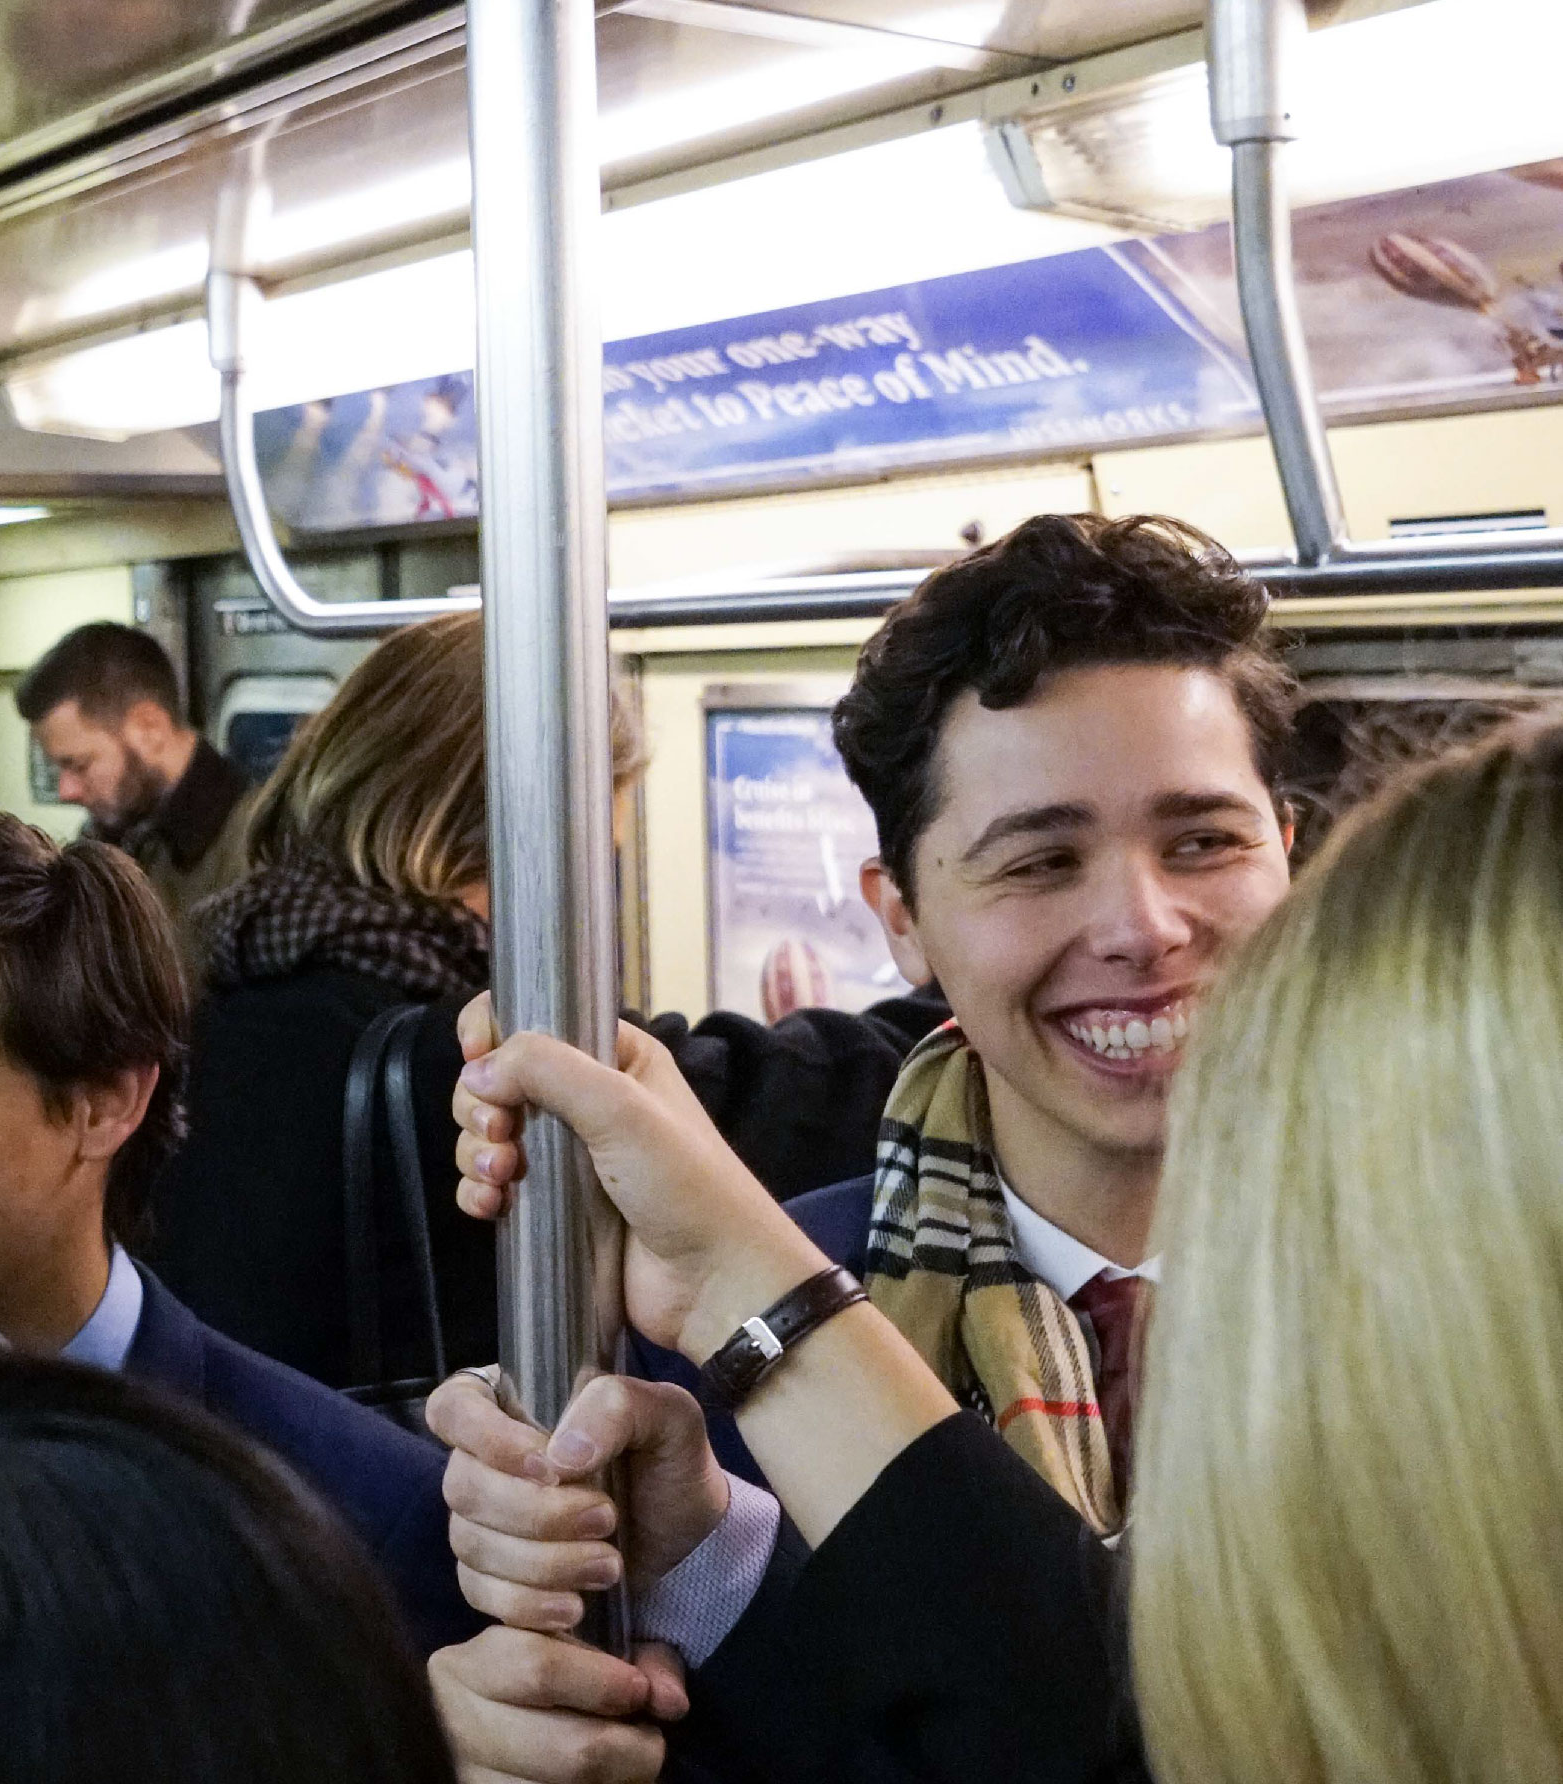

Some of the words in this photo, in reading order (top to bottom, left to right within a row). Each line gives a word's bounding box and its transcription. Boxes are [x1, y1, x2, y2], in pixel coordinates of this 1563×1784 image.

[624, 347, 730, 393] your
[725, 312, 921, 369] one-way
[690, 393, 746, 428] to
[735, 374, 876, 421] Peace
[873, 352, 932, 404] of
[919, 335, 1089, 393] Mind.
